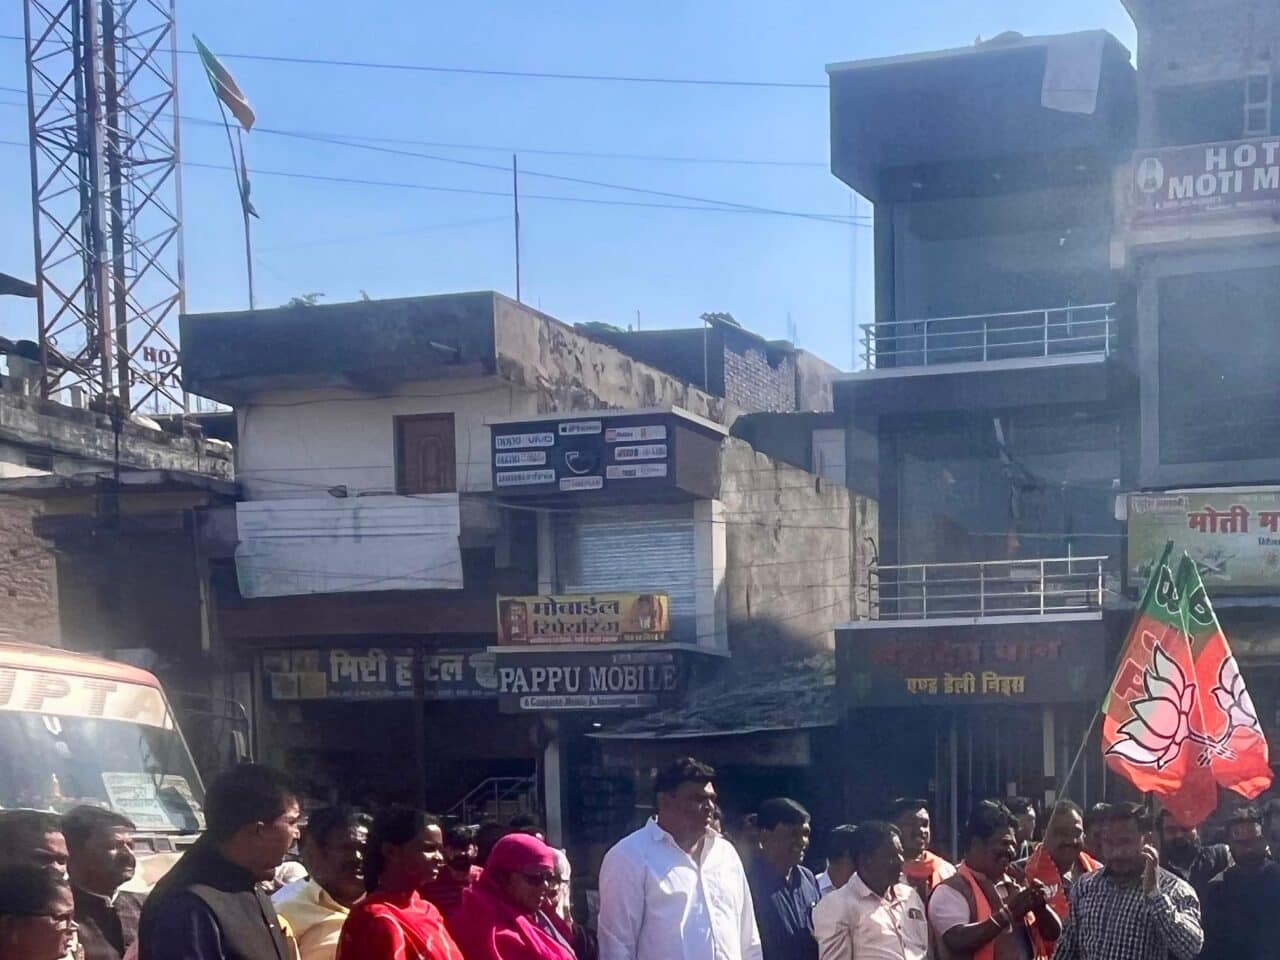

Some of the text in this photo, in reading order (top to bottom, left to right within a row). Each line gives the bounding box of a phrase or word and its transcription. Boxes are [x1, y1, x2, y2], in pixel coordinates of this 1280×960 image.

[1168, 170, 1243, 200] MOTI
[1187, 505, 1251, 534] मोती
[499, 667, 581, 693] PAPPU
[588, 664, 677, 692] MOBILE
